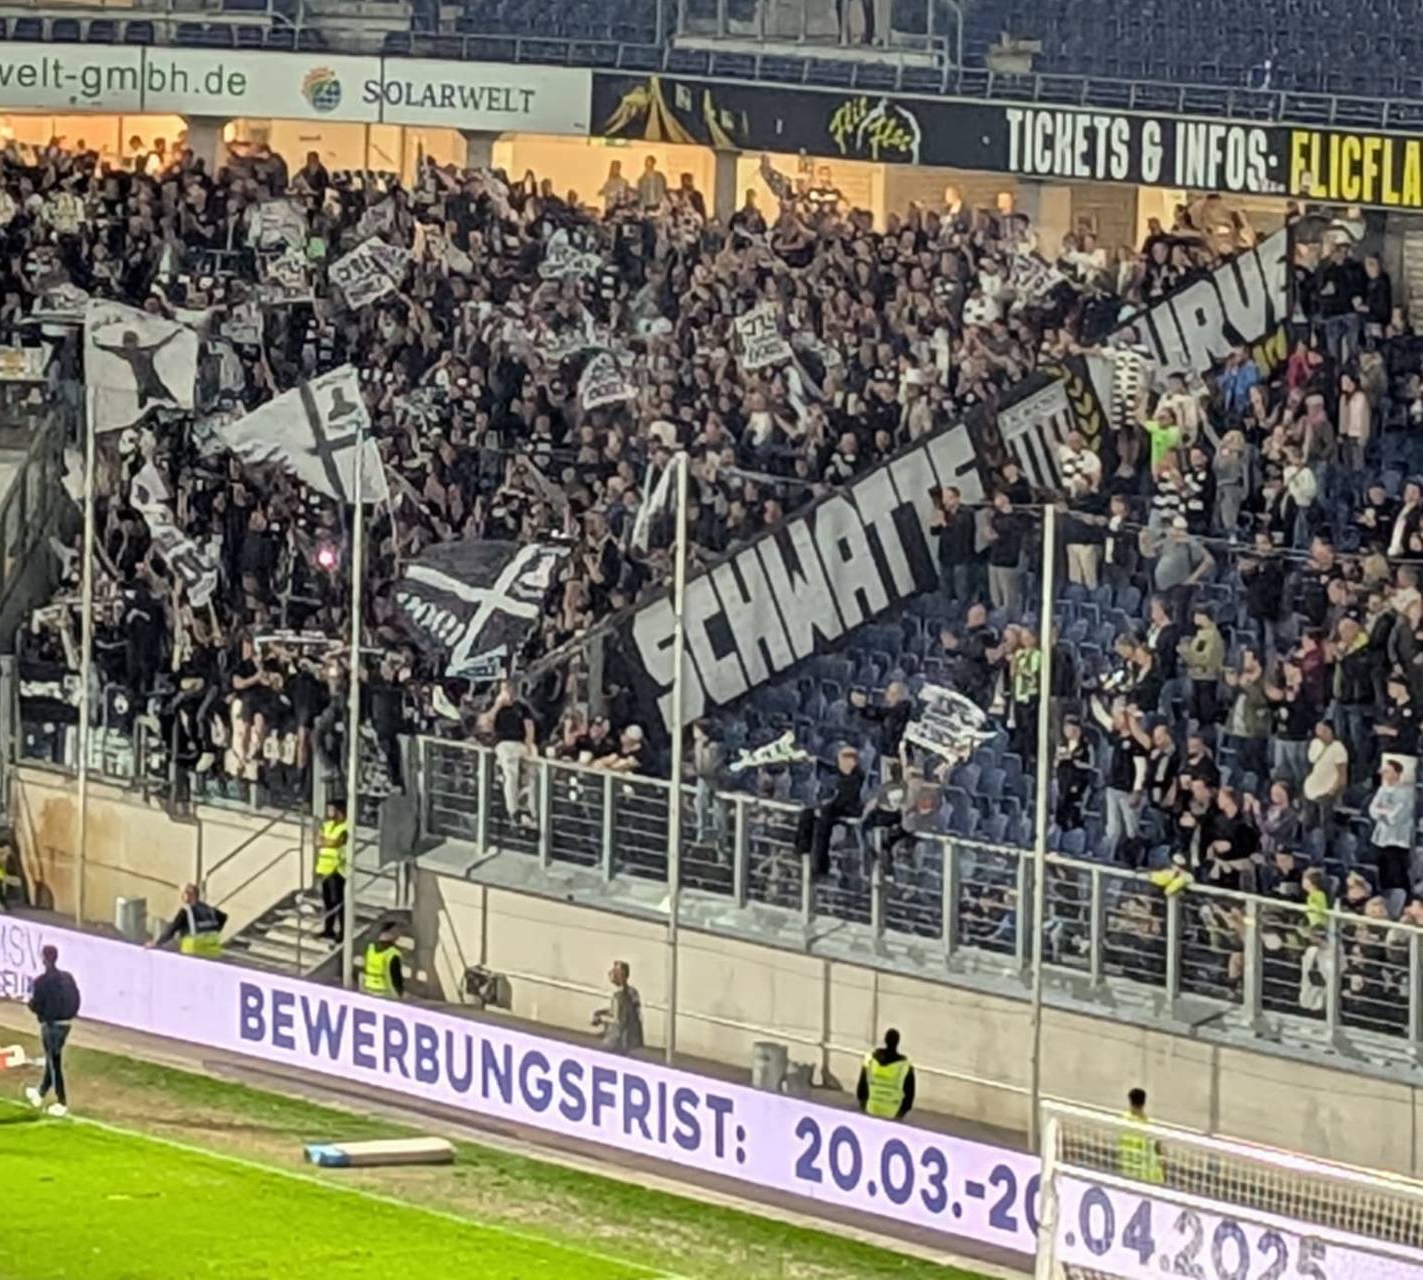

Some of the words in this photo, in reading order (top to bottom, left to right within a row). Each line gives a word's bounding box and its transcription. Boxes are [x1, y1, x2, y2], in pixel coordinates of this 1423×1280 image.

[362, 79, 536, 114] SOLARWELT
[1006, 108, 1131, 181] TICKETS
[1141, 119, 1163, 184] &
[1290, 130, 1423, 206] FLICFLA
[633, 424, 983, 731] SCHWATTE
[239, 981, 747, 1164] BEWERBUNGSFRIST:
